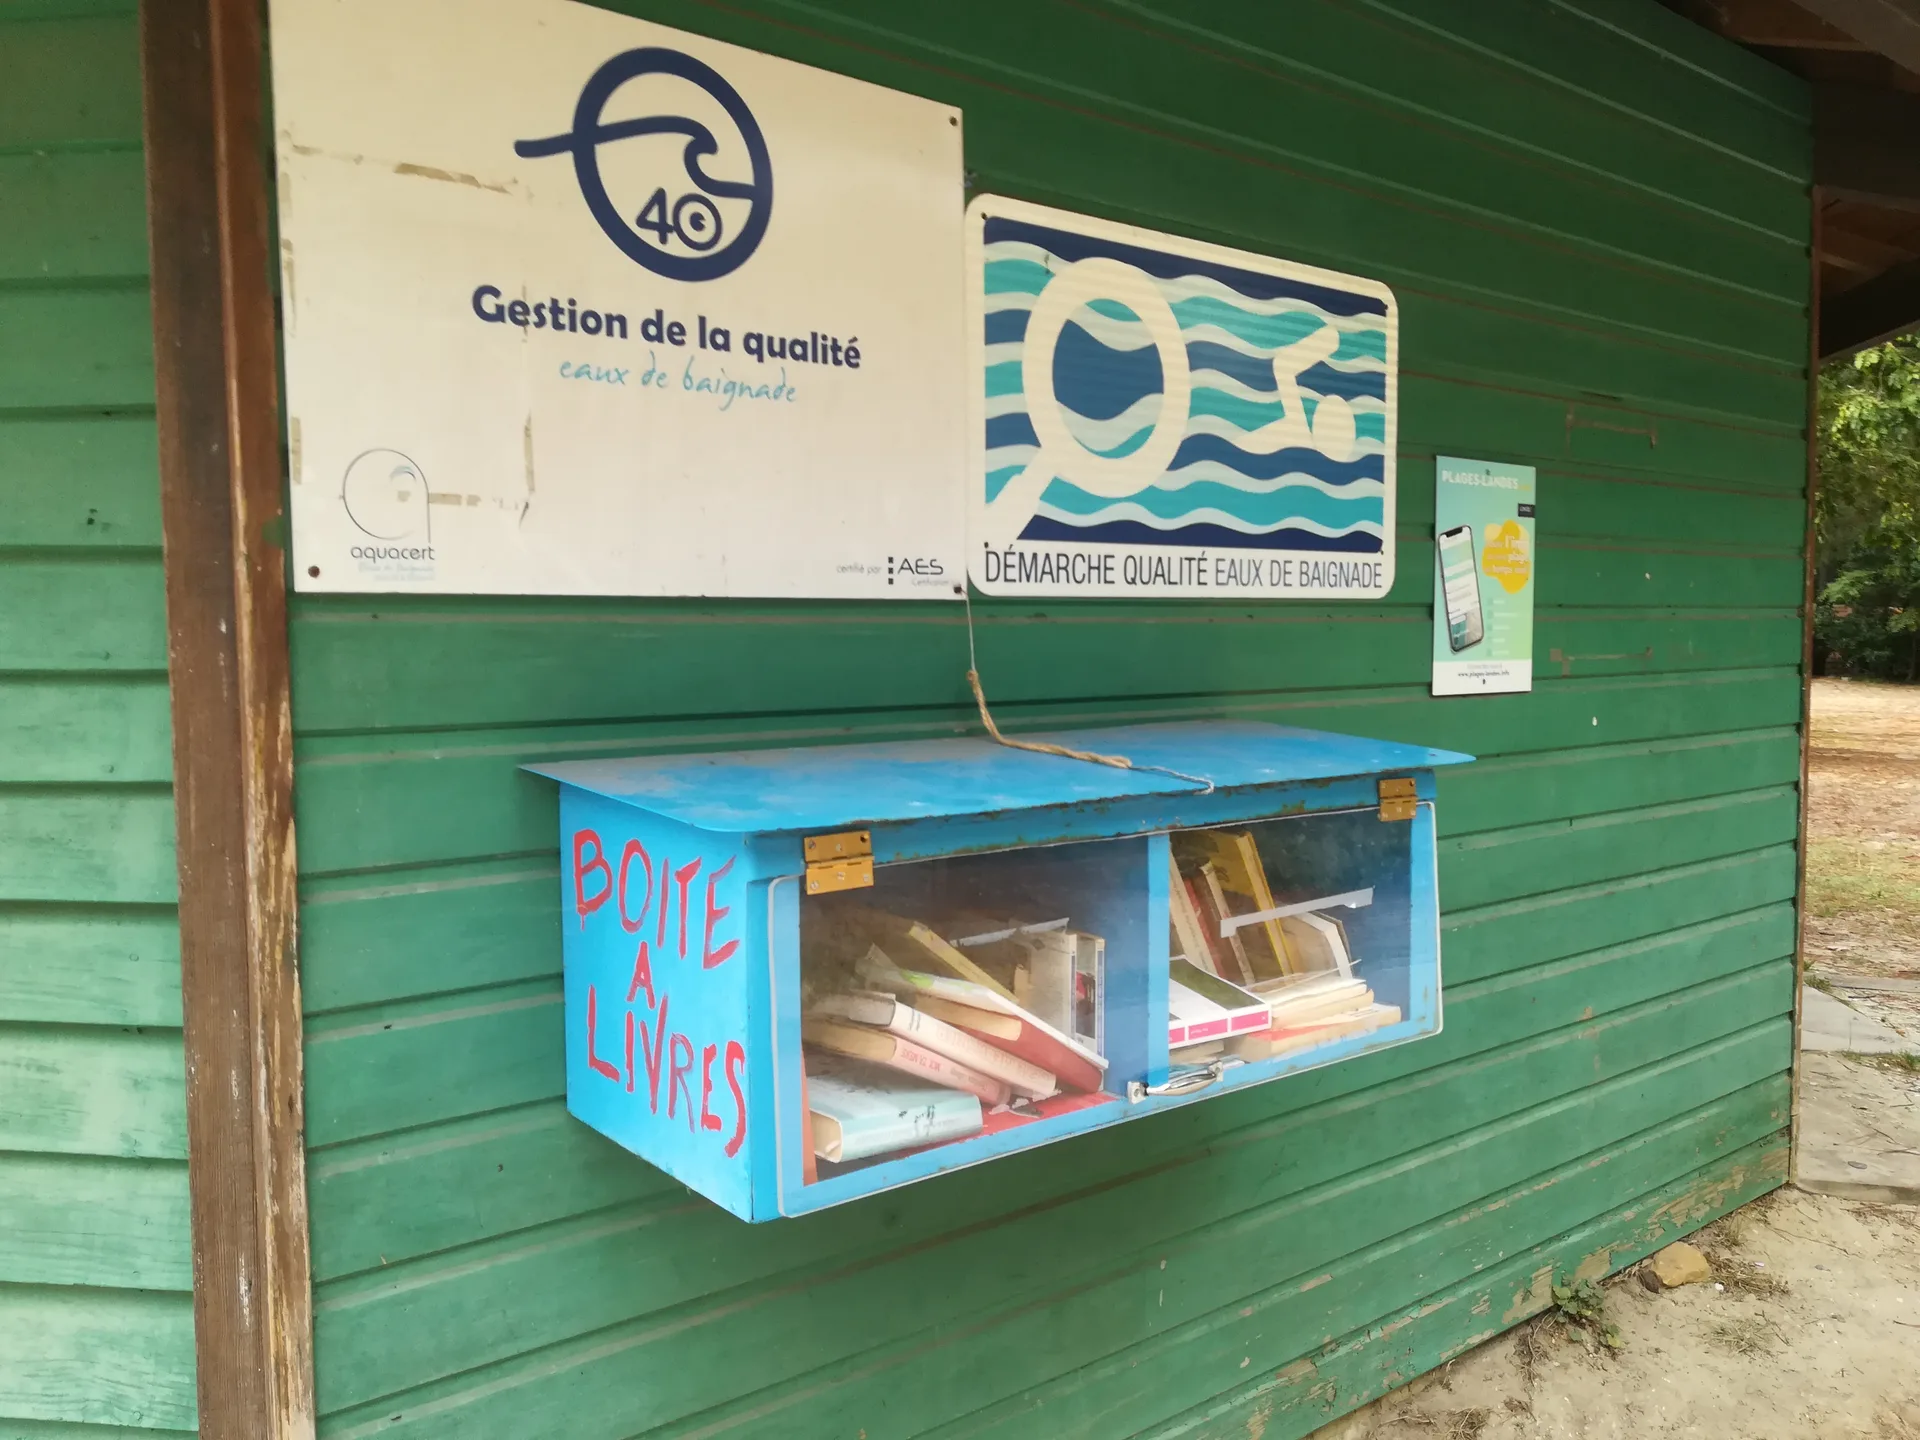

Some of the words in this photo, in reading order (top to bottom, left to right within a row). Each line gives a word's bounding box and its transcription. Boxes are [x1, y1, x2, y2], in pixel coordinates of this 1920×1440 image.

[472, 285, 628, 339] Gestion
[641, 309, 686, 346] de
[699, 315, 731, 352] la
[743, 330, 862, 369] qualité
[559, 358, 629, 385] eaux
[641, 350, 668, 388] de
[682, 355, 797, 411] baignade
[350, 546, 435, 564] aquacert
[897, 558, 944, 575] AES
[985, 544, 1115, 585] DÉMARCHE
[1123, 550, 1208, 586] QUALITÉ
[1215, 558, 1263, 587] EAUX
[1270, 560, 1293, 587] DE
[1300, 561, 1382, 588] BAIGNADE
[573, 829, 740, 969] BOITE
[626, 941, 656, 1010] A
[588, 984, 746, 1158] LIVRES
